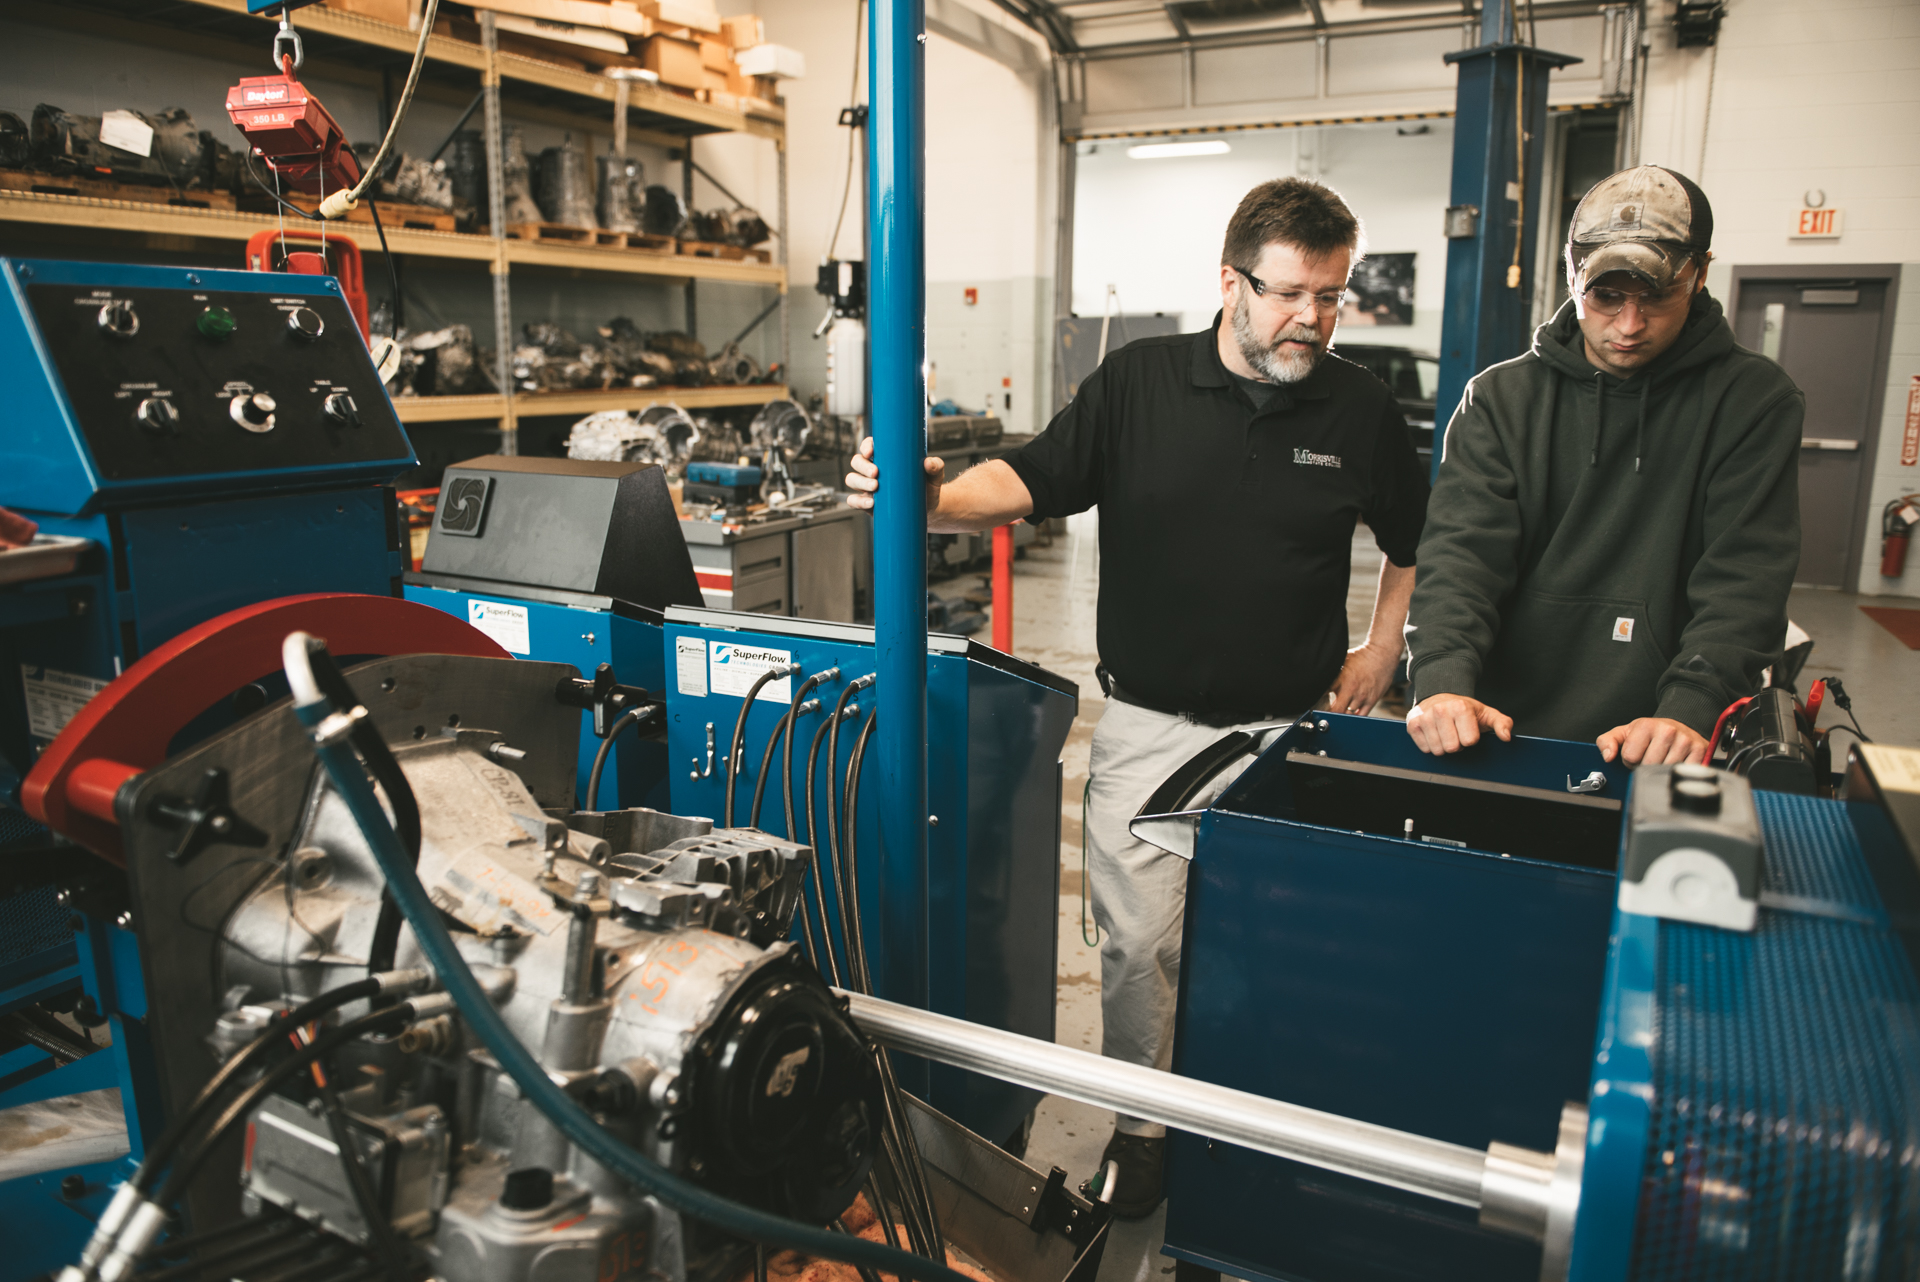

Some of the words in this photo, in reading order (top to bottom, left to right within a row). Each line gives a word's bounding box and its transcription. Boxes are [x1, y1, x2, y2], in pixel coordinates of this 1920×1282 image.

[247, 90, 283, 102] Dayton
[253, 115, 270, 124] 350
[272, 113, 285, 122] LB
[1799, 209, 1836, 234] EXIT
[486, 606, 524, 619] SuperFlow
[733, 648, 786, 664] SuperFlow
[794, 650, 800, 660] 6
[833, 657, 839, 666] 3
[674, 713, 681, 723] C
